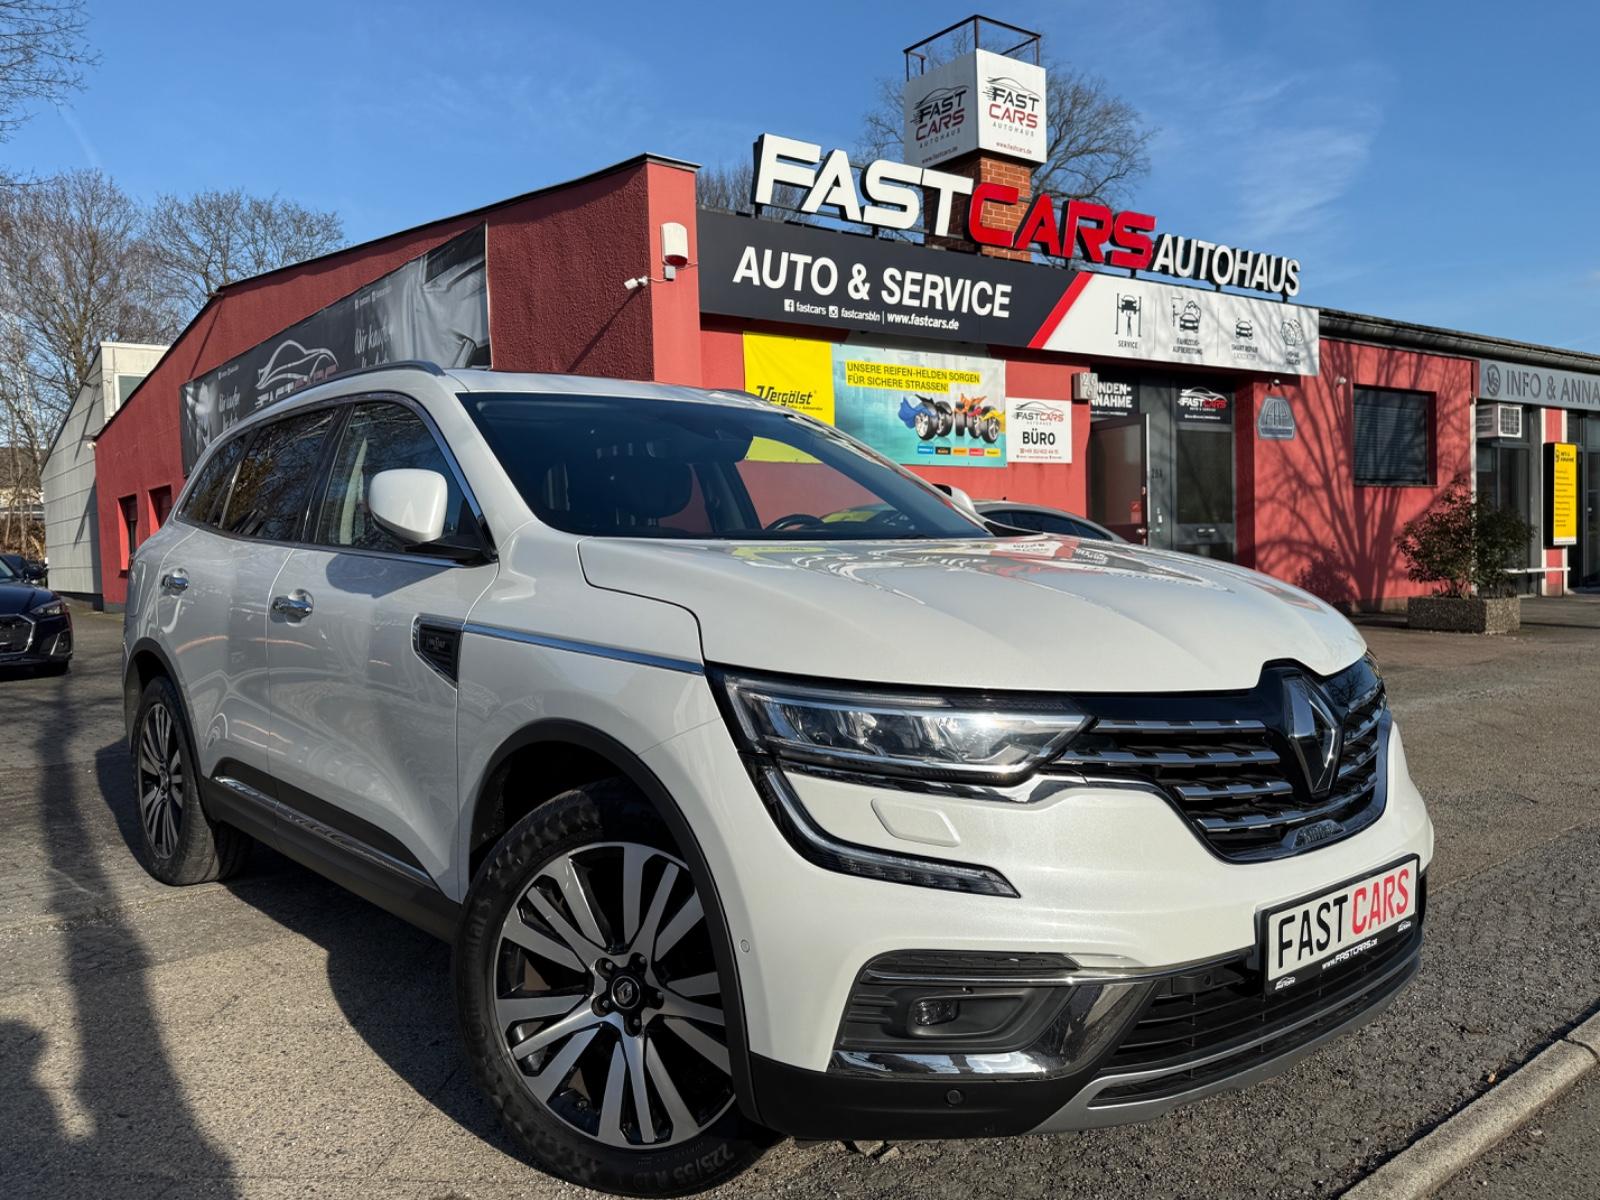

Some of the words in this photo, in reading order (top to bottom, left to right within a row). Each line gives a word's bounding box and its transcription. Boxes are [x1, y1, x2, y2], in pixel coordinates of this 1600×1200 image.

[919, 89, 967, 123] FAST
[992, 86, 1040, 112] FAST
[915, 108, 965, 141] CARS
[988, 103, 1038, 129] CARS
[992, 122, 1035, 137] AUTOHAUS
[1152, 233, 1301, 298] AUTOHAUS
[732, 245, 839, 296] AUTO
[847, 263, 871, 301] &
[880, 266, 1013, 319] SERVICE
[796, 301, 827, 315] fastcars
[886, 311, 960, 331] www.fastcars.de
[847, 362, 882, 374] UNSERE
[884, 365, 947, 380] REIFEN-HELDEN
[948, 373, 980, 383] SORGEN
[847, 372, 865, 384] FÜR
[867, 376, 905, 388] SICHERE
[905, 379, 949, 392] STRASSEN!
[756, 385, 813, 406] Vergölst
[1097, 381, 1132, 395] NDEN-
[1506, 369, 1542, 399] INFO
[1546, 375, 1556, 400] &
[1560, 377, 1600, 405] ANNA
[1022, 427, 1056, 446] BÜRO
